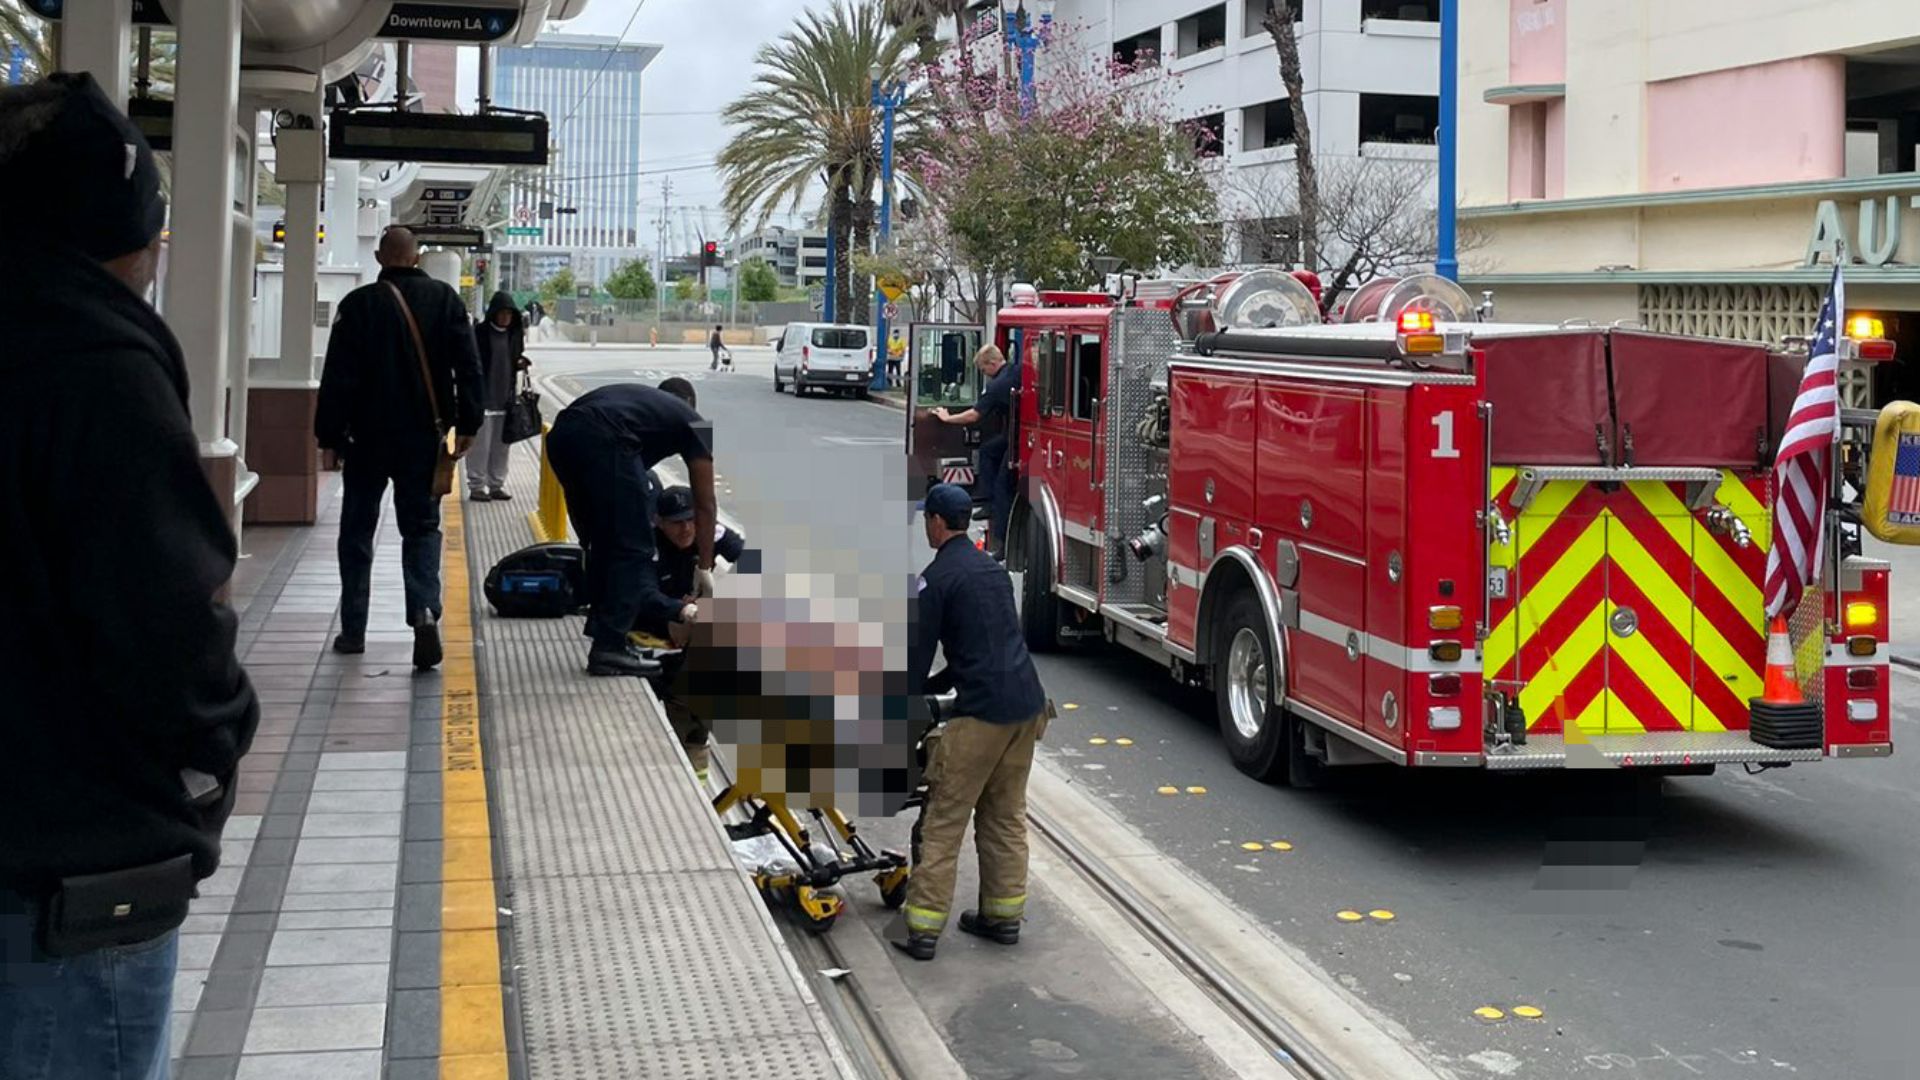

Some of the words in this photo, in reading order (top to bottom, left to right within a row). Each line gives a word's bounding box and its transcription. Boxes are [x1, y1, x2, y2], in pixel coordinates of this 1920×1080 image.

[390, 14, 460, 29] Downtown
[464, 18, 482, 30] LA
[1805, 195, 1920, 266] AU
[1431, 410, 1460, 458] 1
